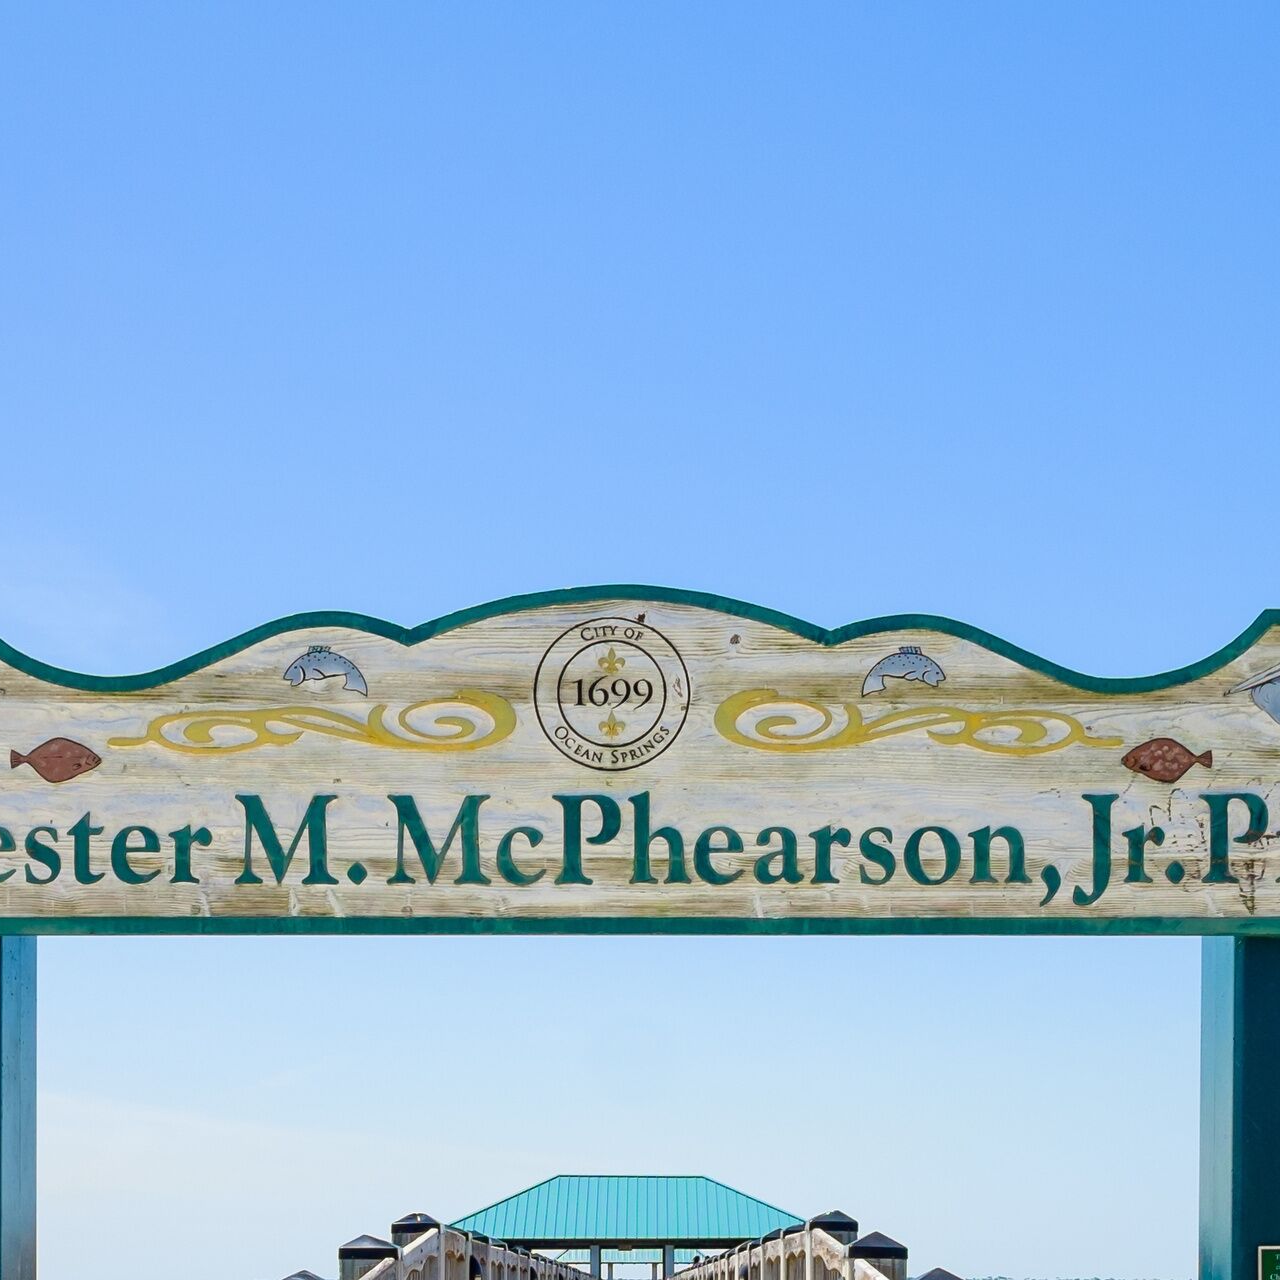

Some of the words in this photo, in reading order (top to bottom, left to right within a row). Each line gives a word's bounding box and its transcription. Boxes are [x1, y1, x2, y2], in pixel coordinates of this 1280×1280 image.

[572, 675, 653, 711] 1699
[234, 793, 369, 887] M.
[387, 790, 1061, 906] McPhearson,
[1071, 793, 1186, 907] Jr.
